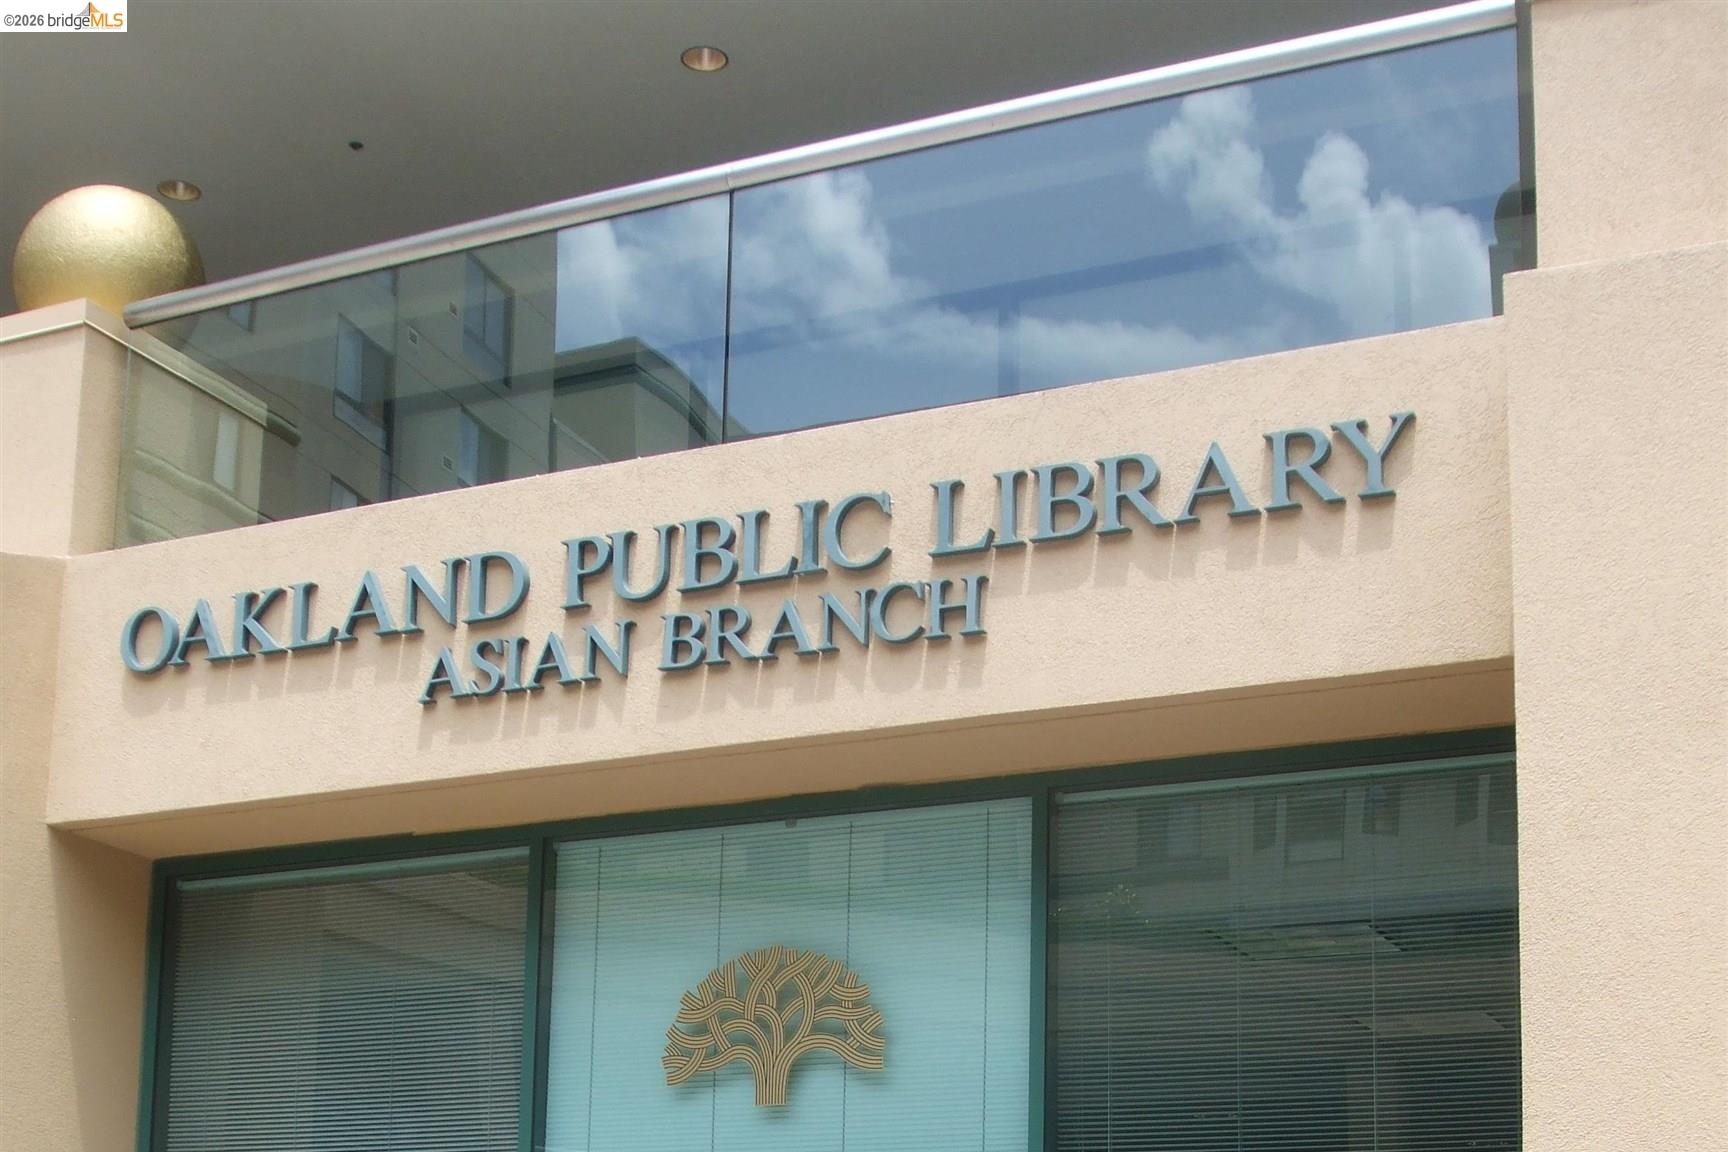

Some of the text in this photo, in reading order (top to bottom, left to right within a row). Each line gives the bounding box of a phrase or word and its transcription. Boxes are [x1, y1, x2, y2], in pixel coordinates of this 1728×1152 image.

[121, 411, 1417, 673] OAKLAND PUBLIC LIBRARY
[418, 575, 989, 704] ASIAN BRANCH
